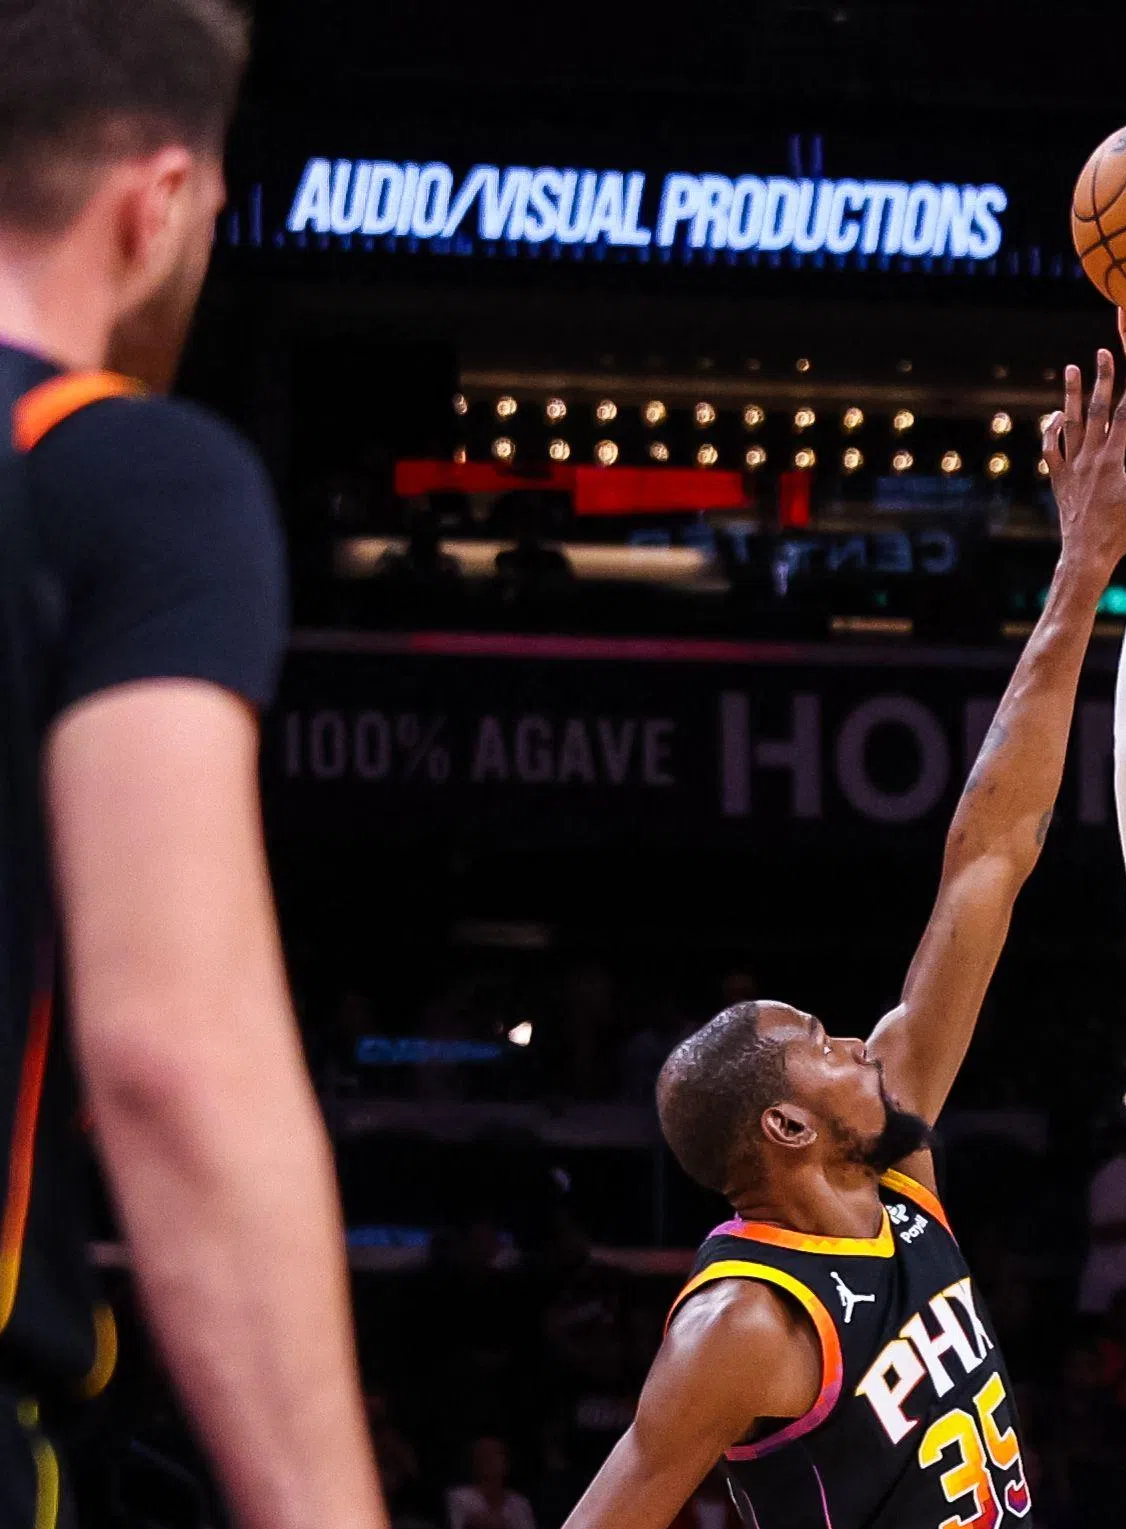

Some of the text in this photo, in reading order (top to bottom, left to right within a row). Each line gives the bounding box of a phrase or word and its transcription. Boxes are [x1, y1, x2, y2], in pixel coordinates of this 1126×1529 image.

[287, 157, 1008, 260] AUDIO/VISUAL PRODUCTIONS
[283, 708, 453, 785] 100%
[470, 712, 680, 788] AGAVE
[855, 1276, 995, 1446] PHX
